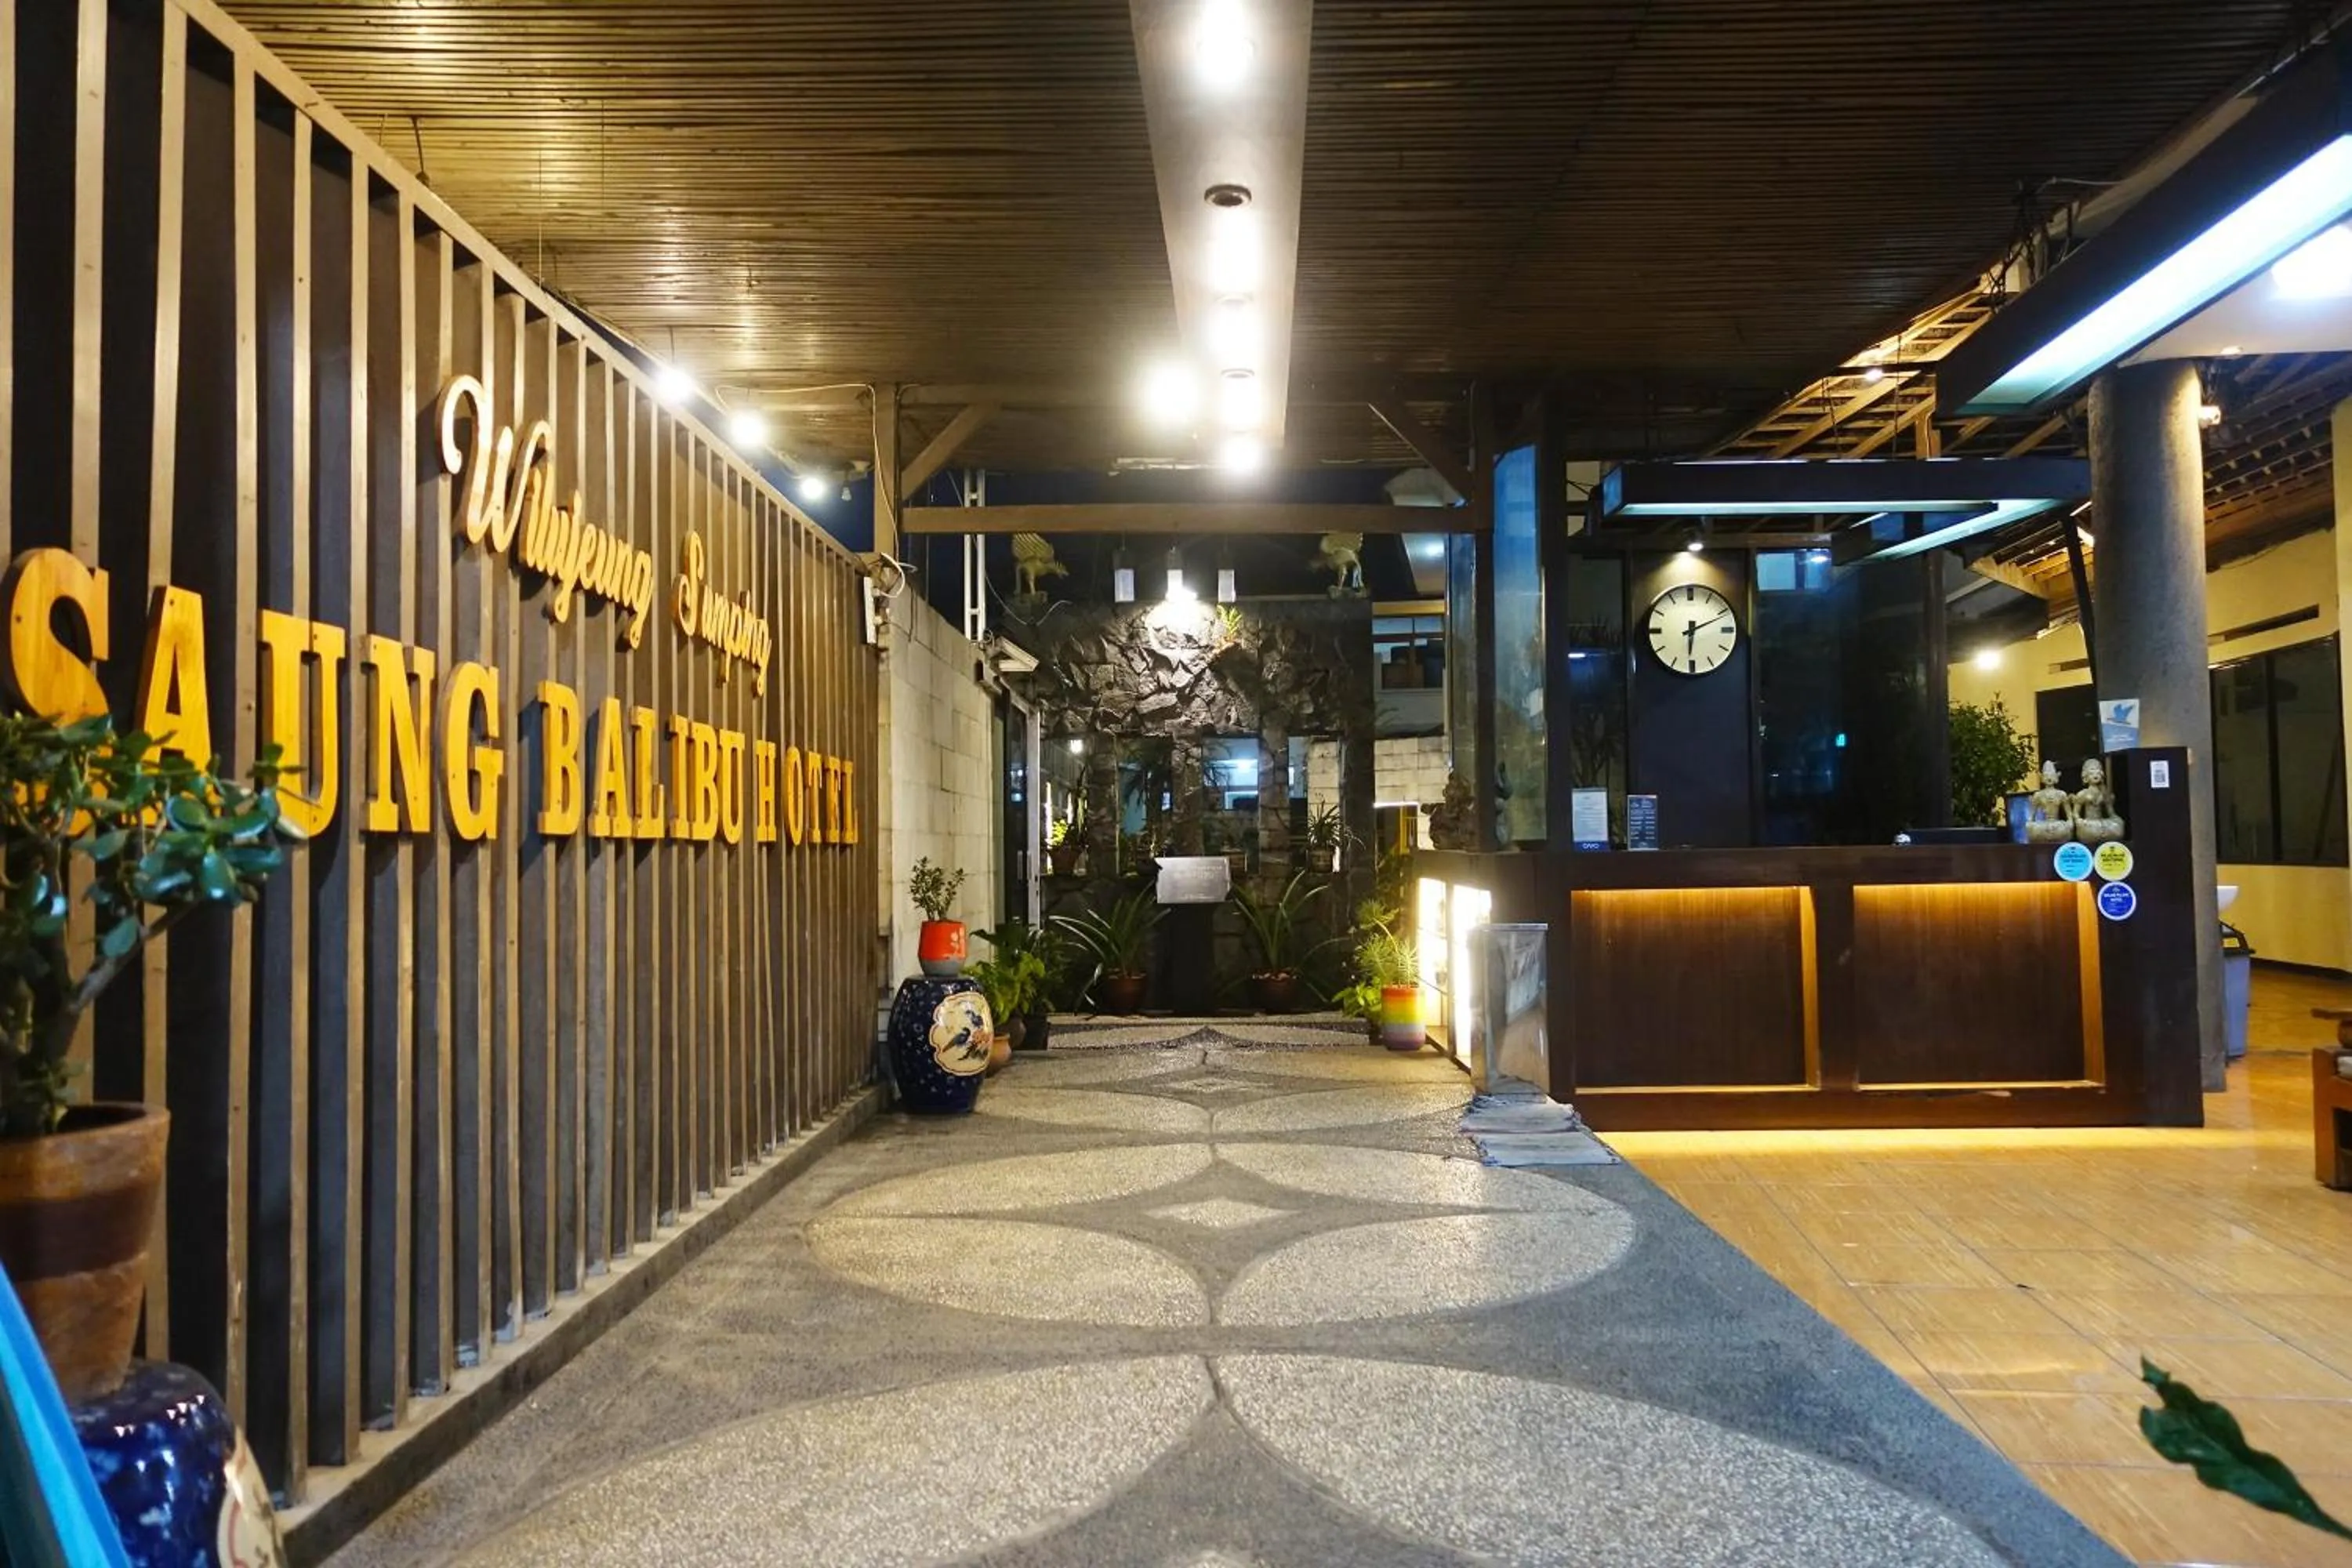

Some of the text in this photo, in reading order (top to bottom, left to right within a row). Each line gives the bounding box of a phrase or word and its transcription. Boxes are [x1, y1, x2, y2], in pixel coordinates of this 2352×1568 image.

[8, 546, 858, 846] SAUNG BALIBU HOTEL
[674, 530, 772, 697] Sumping
